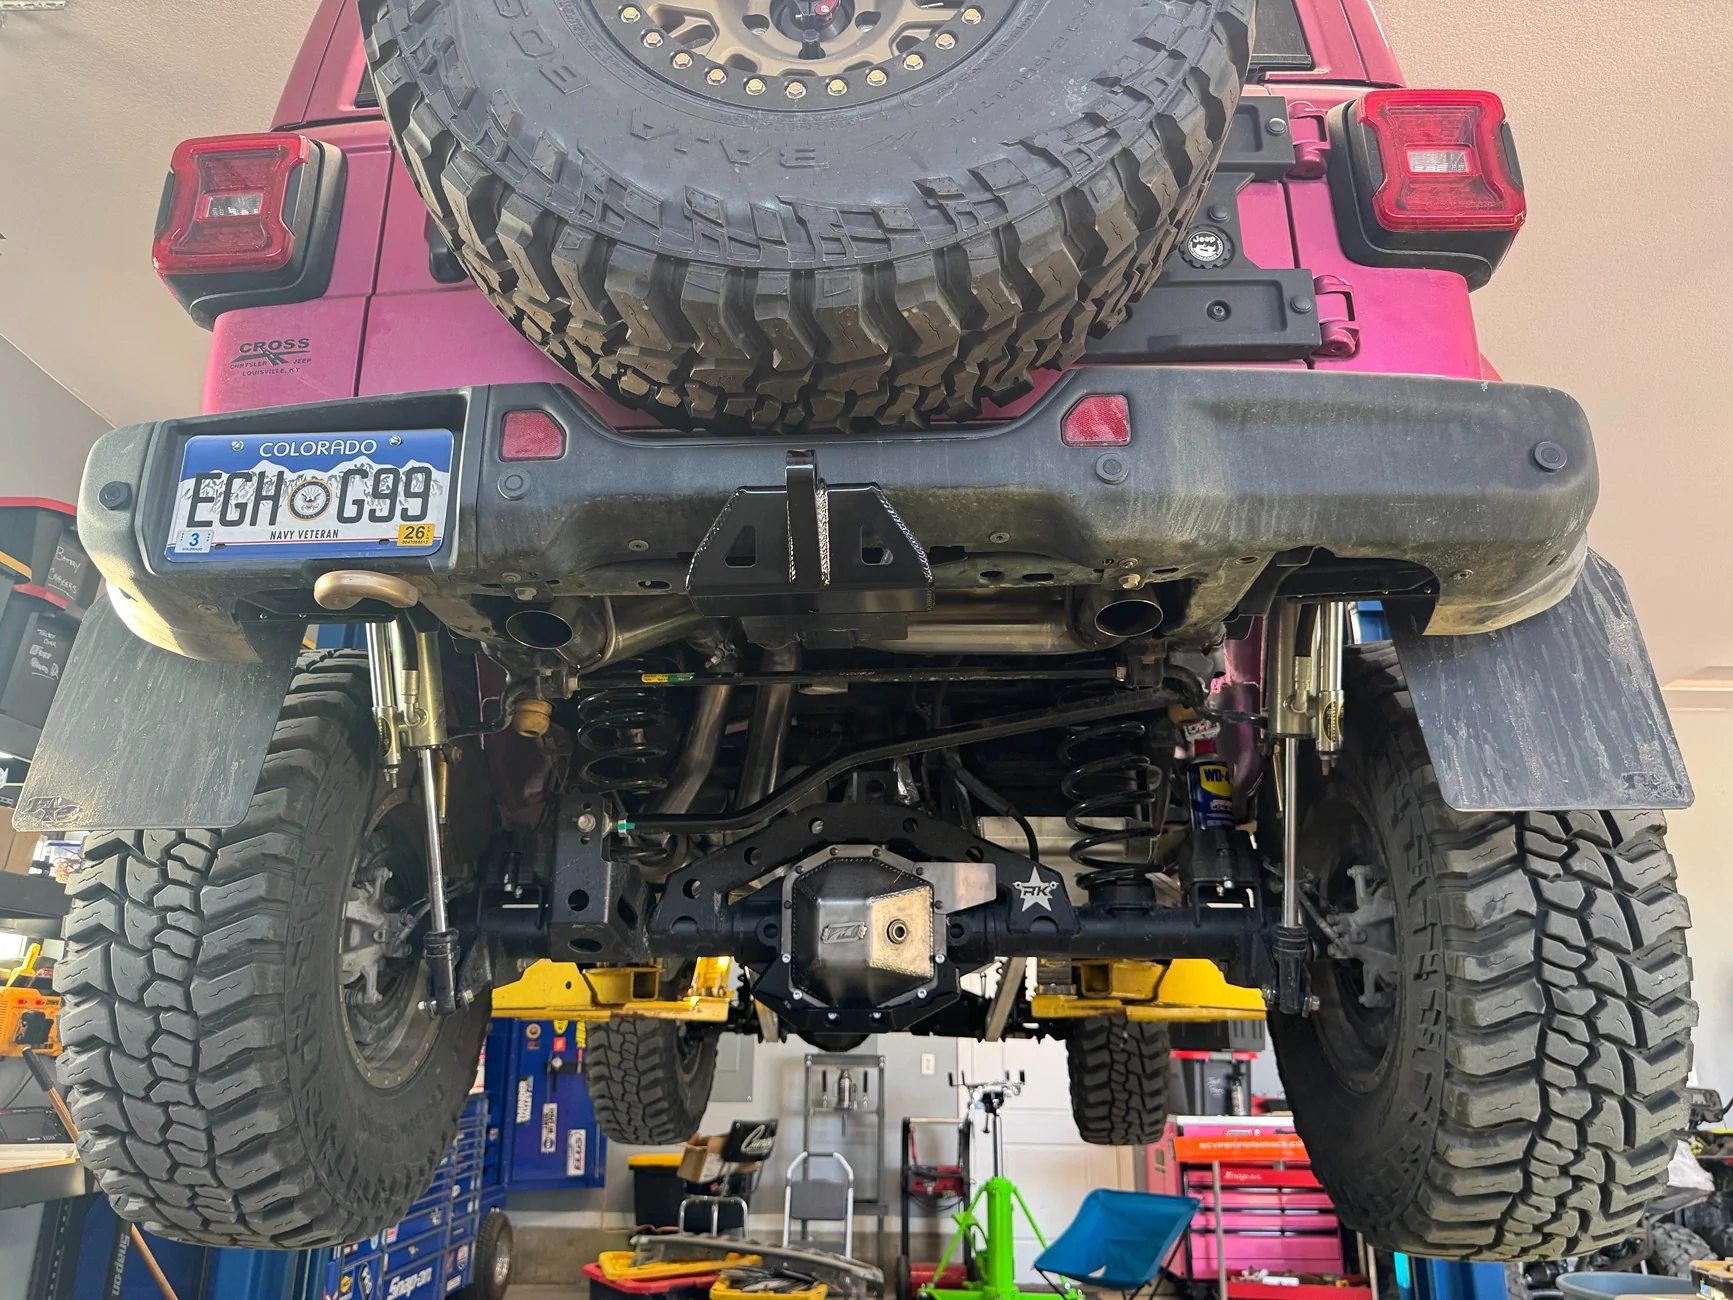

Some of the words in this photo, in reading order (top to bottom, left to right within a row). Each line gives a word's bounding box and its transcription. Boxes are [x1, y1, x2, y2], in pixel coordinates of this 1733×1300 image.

[1193, 235, 1216, 243] Jeep
[239, 338, 310, 352] CROSS
[230, 360, 268, 370] CHRYSLER
[242, 368, 287, 377] LOUISVILLE,
[259, 439, 377, 458] COLORADO
[186, 470, 285, 528] EGH
[336, 466, 433, 524] G99
[270, 530, 295, 540] NAVY
[298, 529, 339, 539] VETERAN
[403, 525, 426, 539] 26
[189, 532, 200, 547] 3
